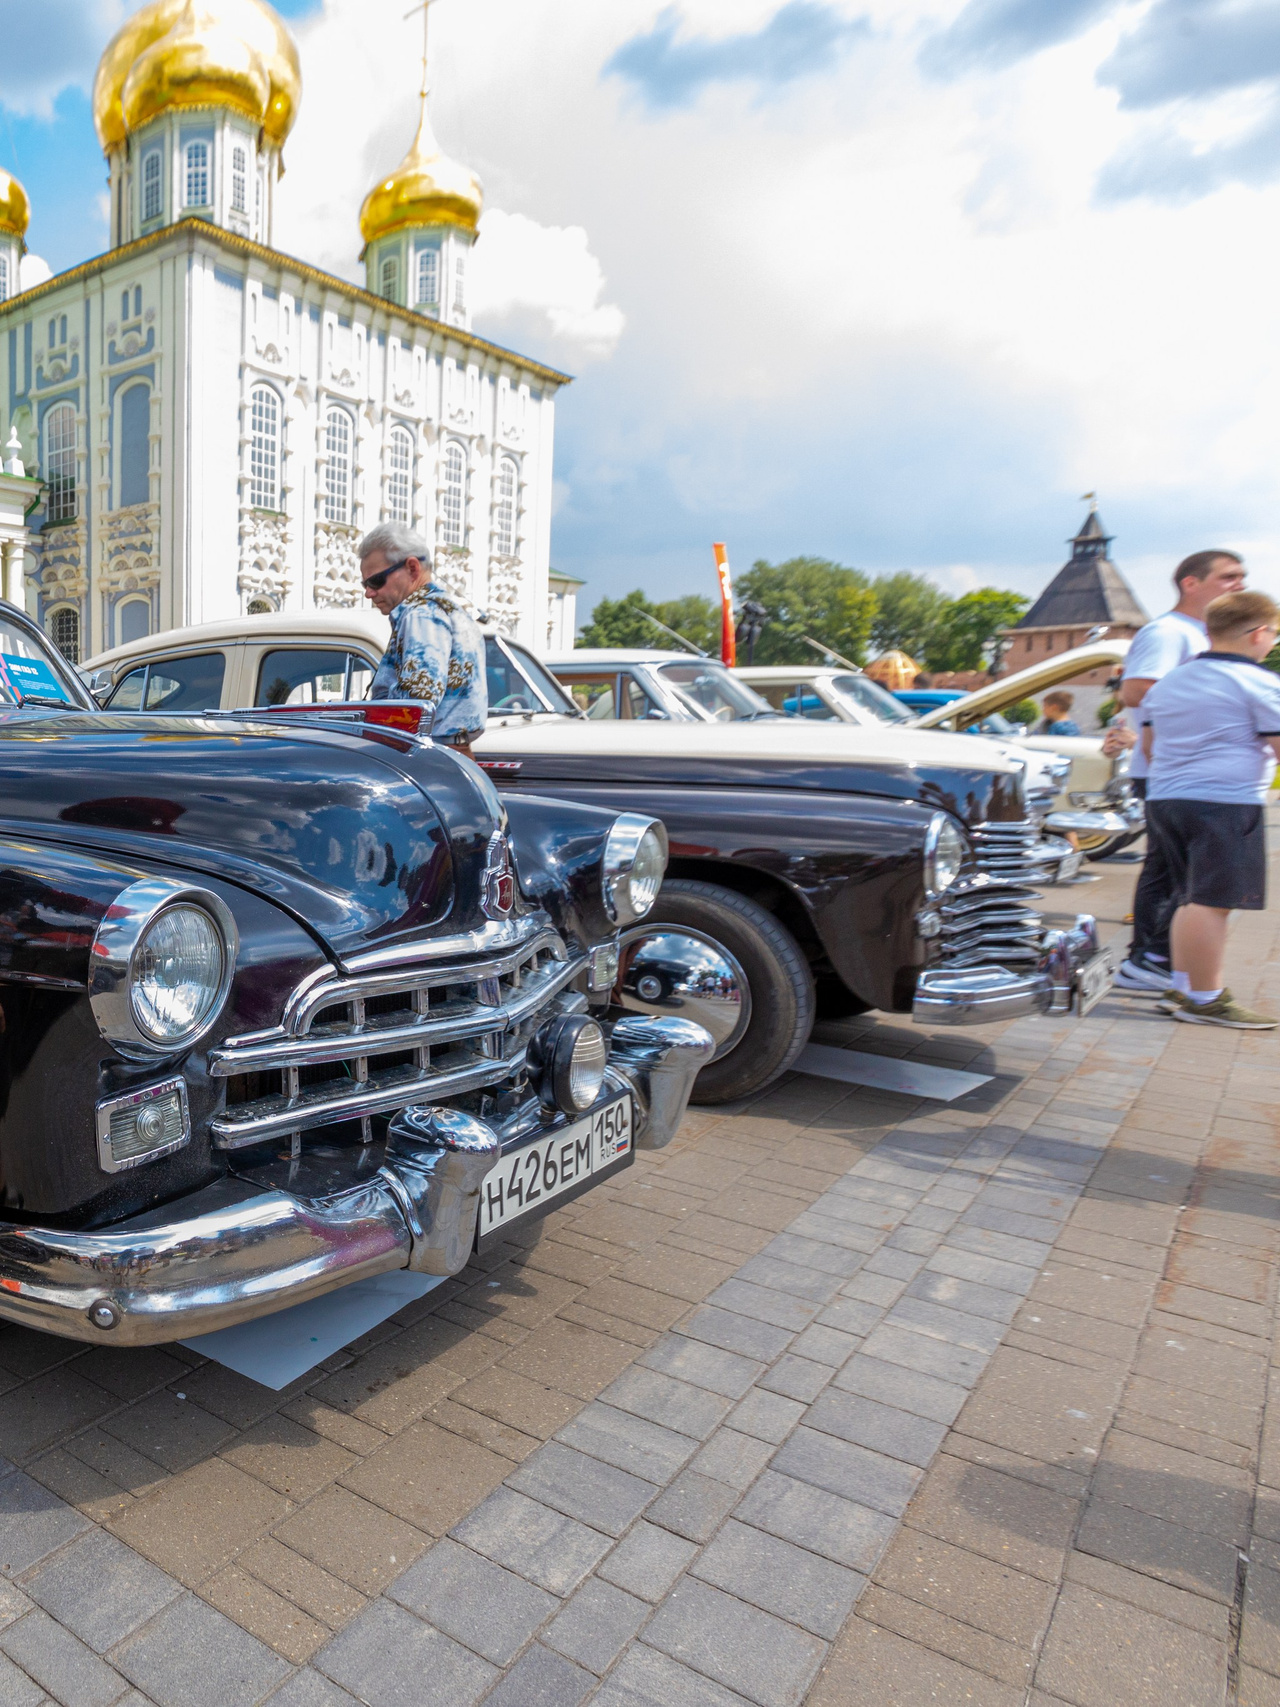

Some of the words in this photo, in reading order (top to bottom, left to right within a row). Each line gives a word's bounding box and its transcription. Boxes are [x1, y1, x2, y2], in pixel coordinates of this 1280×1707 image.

[486, 1133, 592, 1223] Н426ЕМ
[595, 1102, 625, 1148] 150
[600, 1145, 617, 1162] RUS
